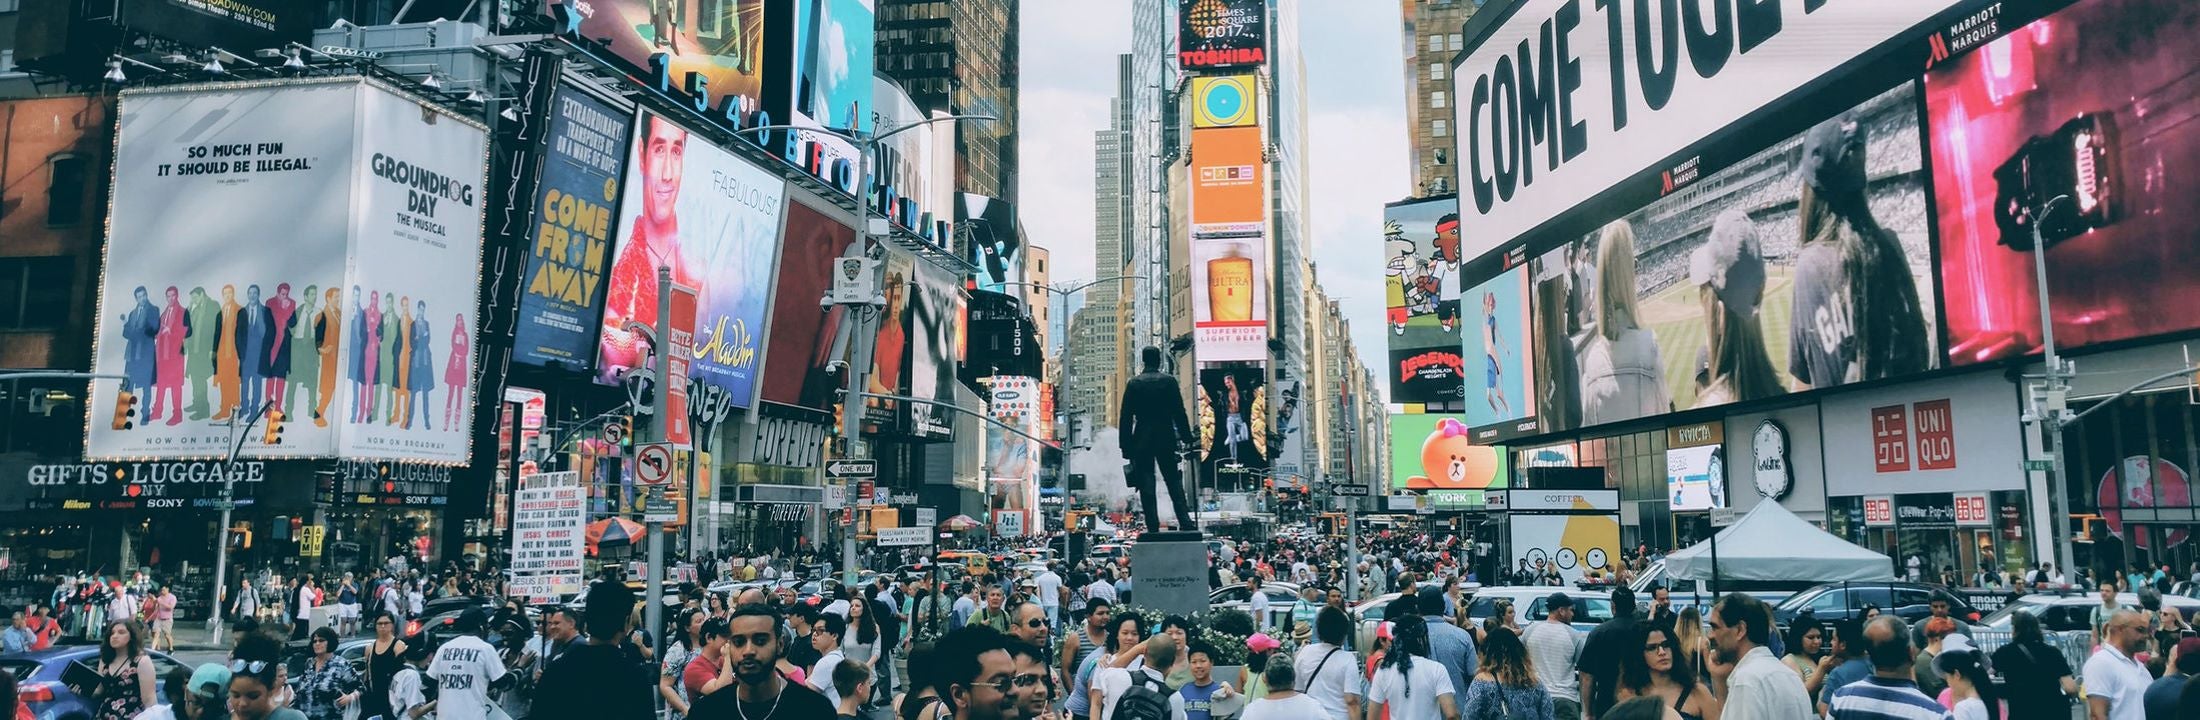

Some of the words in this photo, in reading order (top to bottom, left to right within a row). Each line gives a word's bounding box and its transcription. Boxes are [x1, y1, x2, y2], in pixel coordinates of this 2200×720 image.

[1216, 9, 1245, 17] TIMES
[1221, 15, 1259, 26] SQUARE
[1950, 2, 2002, 37] MARRIOTT
[1205, 24, 1244, 38] 2017
[1952, 21, 1997, 51] MARQUIS
[1181, 47, 1264, 66] TOSHIBA
[1470, 0, 1587, 215] COME
[213, 143, 252, 157] MUCH
[257, 142, 283, 155] FUN
[158, 164, 172, 176] IT
[177, 162, 229, 175] SHOULD
[233, 161, 250, 173] BE
[1674, 155, 1700, 175] MARRIOTT
[371, 152, 473, 207] GROUNDHOG
[408, 189, 438, 218] DAY
[544, 188, 610, 240] COME
[397, 213, 411, 226] THE
[414, 217, 446, 237] MUSICAL
[535, 222, 606, 277] FROM
[528, 261, 601, 308] AWAY
[694, 314, 755, 370] Aladdin
[1013, 319, 1021, 356] 1500
[1201, 335, 1230, 343] LIGHT
[1918, 408, 1946, 433] UNI
[146, 437, 173, 445] NOW
[181, 436, 197, 444] ON
[1679, 425, 1711, 443] INVICTA
[1920, 437, 1951, 466] QLO
[28, 464, 108, 486] GIFTS
[130, 461, 265, 485] LUGGAGE
[389, 462, 452, 483] LUGGAGE
[526, 475, 548, 489] WORD
[550, 474, 559, 487] OF
[562, 473, 576, 486] GOD
[405, 496, 429, 504] SONY
[522, 492, 537, 500] ONLY
[555, 490, 576, 498] GRACE
[1438, 494, 1467, 502] YORK
[1972, 497, 1983, 508] UNI
[63, 499, 91, 509] Nikon
[147, 498, 184, 508] SONY
[771, 504, 801, 521] FOREVER
[1929, 505, 1954, 520] Pop-Up
[1973, 509, 1984, 519] QLO
[516, 521, 544, 529] THROUGH
[569, 519, 576, 527] IN
[303, 527, 311, 551] ATM
[523, 531, 541, 539] JESUS
[546, 530, 571, 538] CHRIST
[518, 551, 526, 559] SO
[560, 549, 574, 557] MAN
[513, 561, 525, 569] CAN
[512, 577, 536, 585] JESUS
[547, 576, 561, 585] THE
[564, 576, 580, 584] ONLY
[511, 586, 528, 594] WAY
[532, 586, 543, 594] TO
[442, 647, 481, 662] REPENT
[440, 674, 474, 690] PERISH
